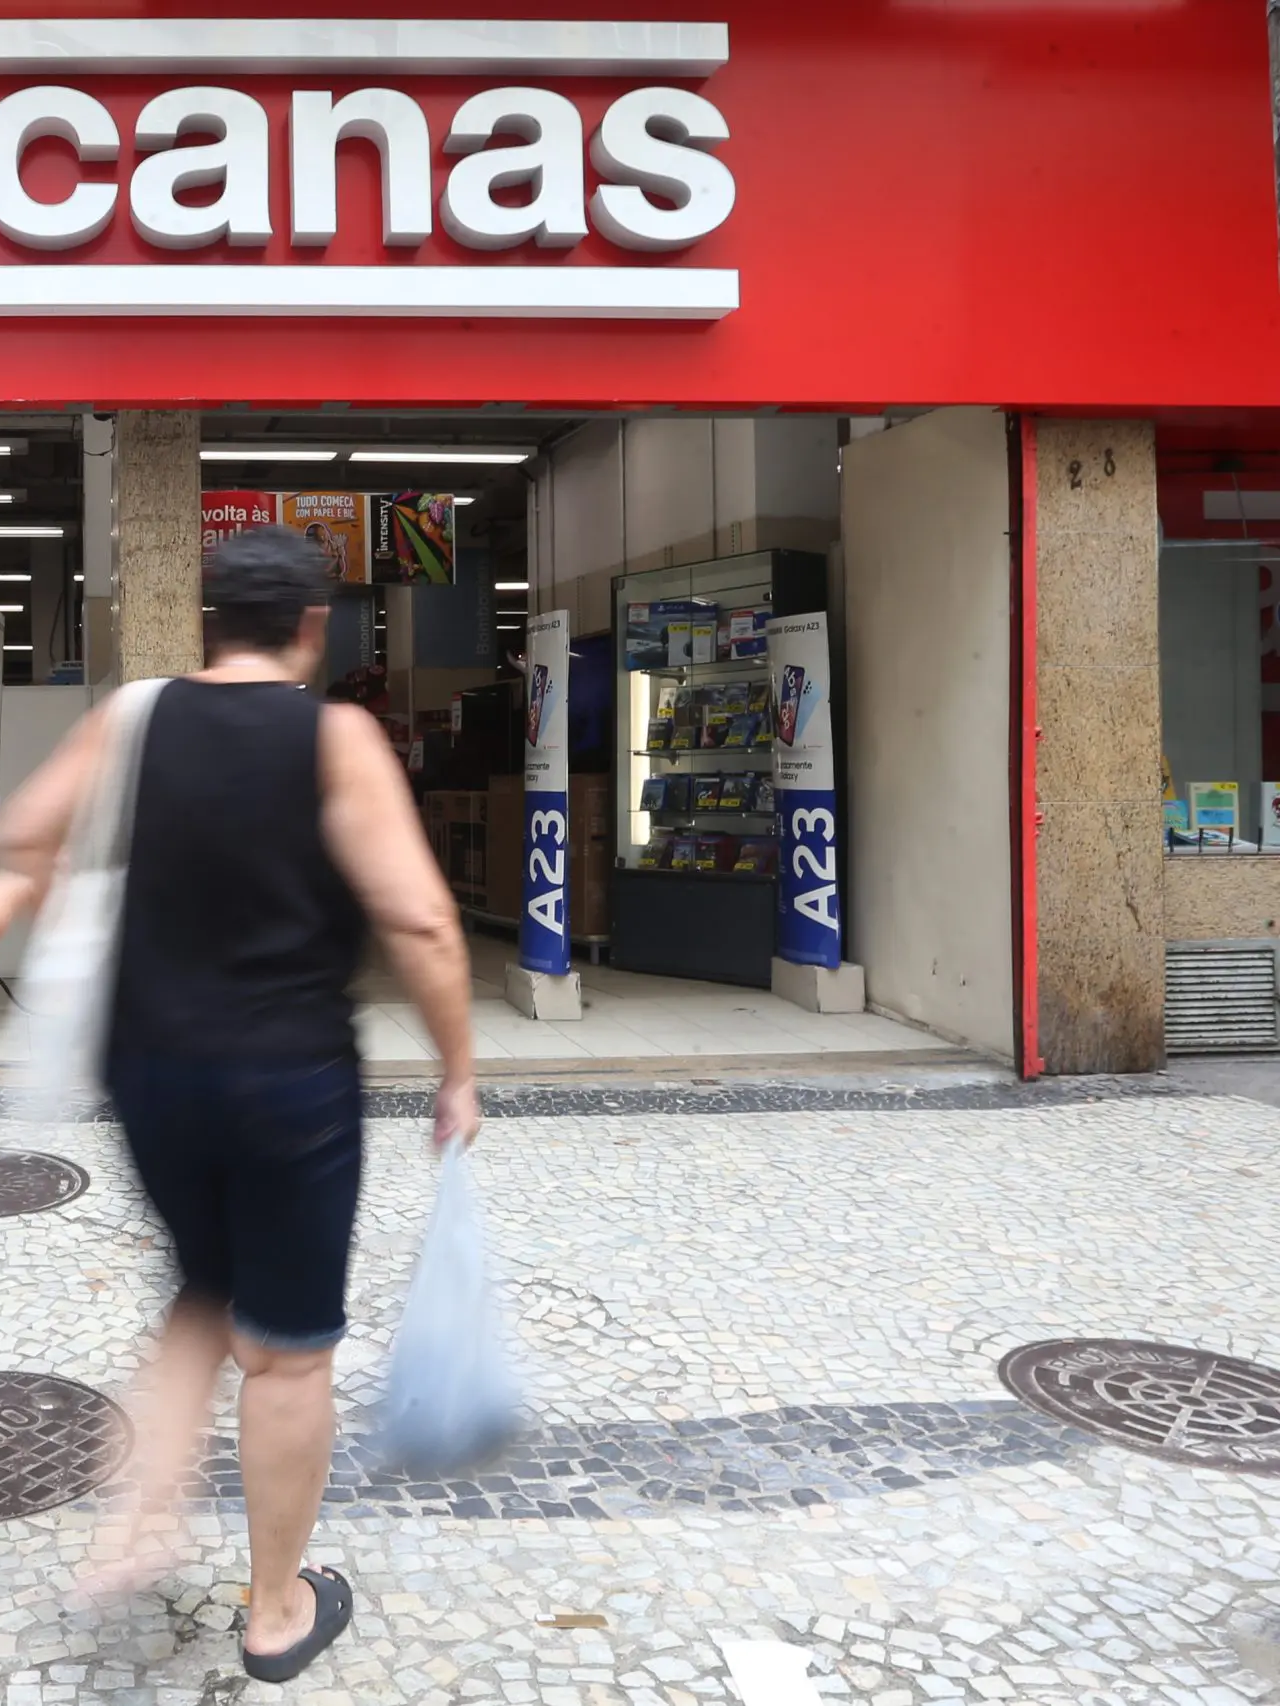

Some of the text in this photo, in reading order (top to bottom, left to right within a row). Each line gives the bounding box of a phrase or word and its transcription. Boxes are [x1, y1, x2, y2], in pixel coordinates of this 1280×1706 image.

[295, 495, 318, 508] TUDO
[202, 505, 270, 523] volta às
[295, 508, 310, 518] COM
[313, 507, 336, 518] PAPEL
[337, 508, 343, 518] E
[783, 624, 806, 634] Galaxy
[806, 621, 820, 630] A23
[528, 810, 566, 936] A23
[792, 808, 839, 932] A23
